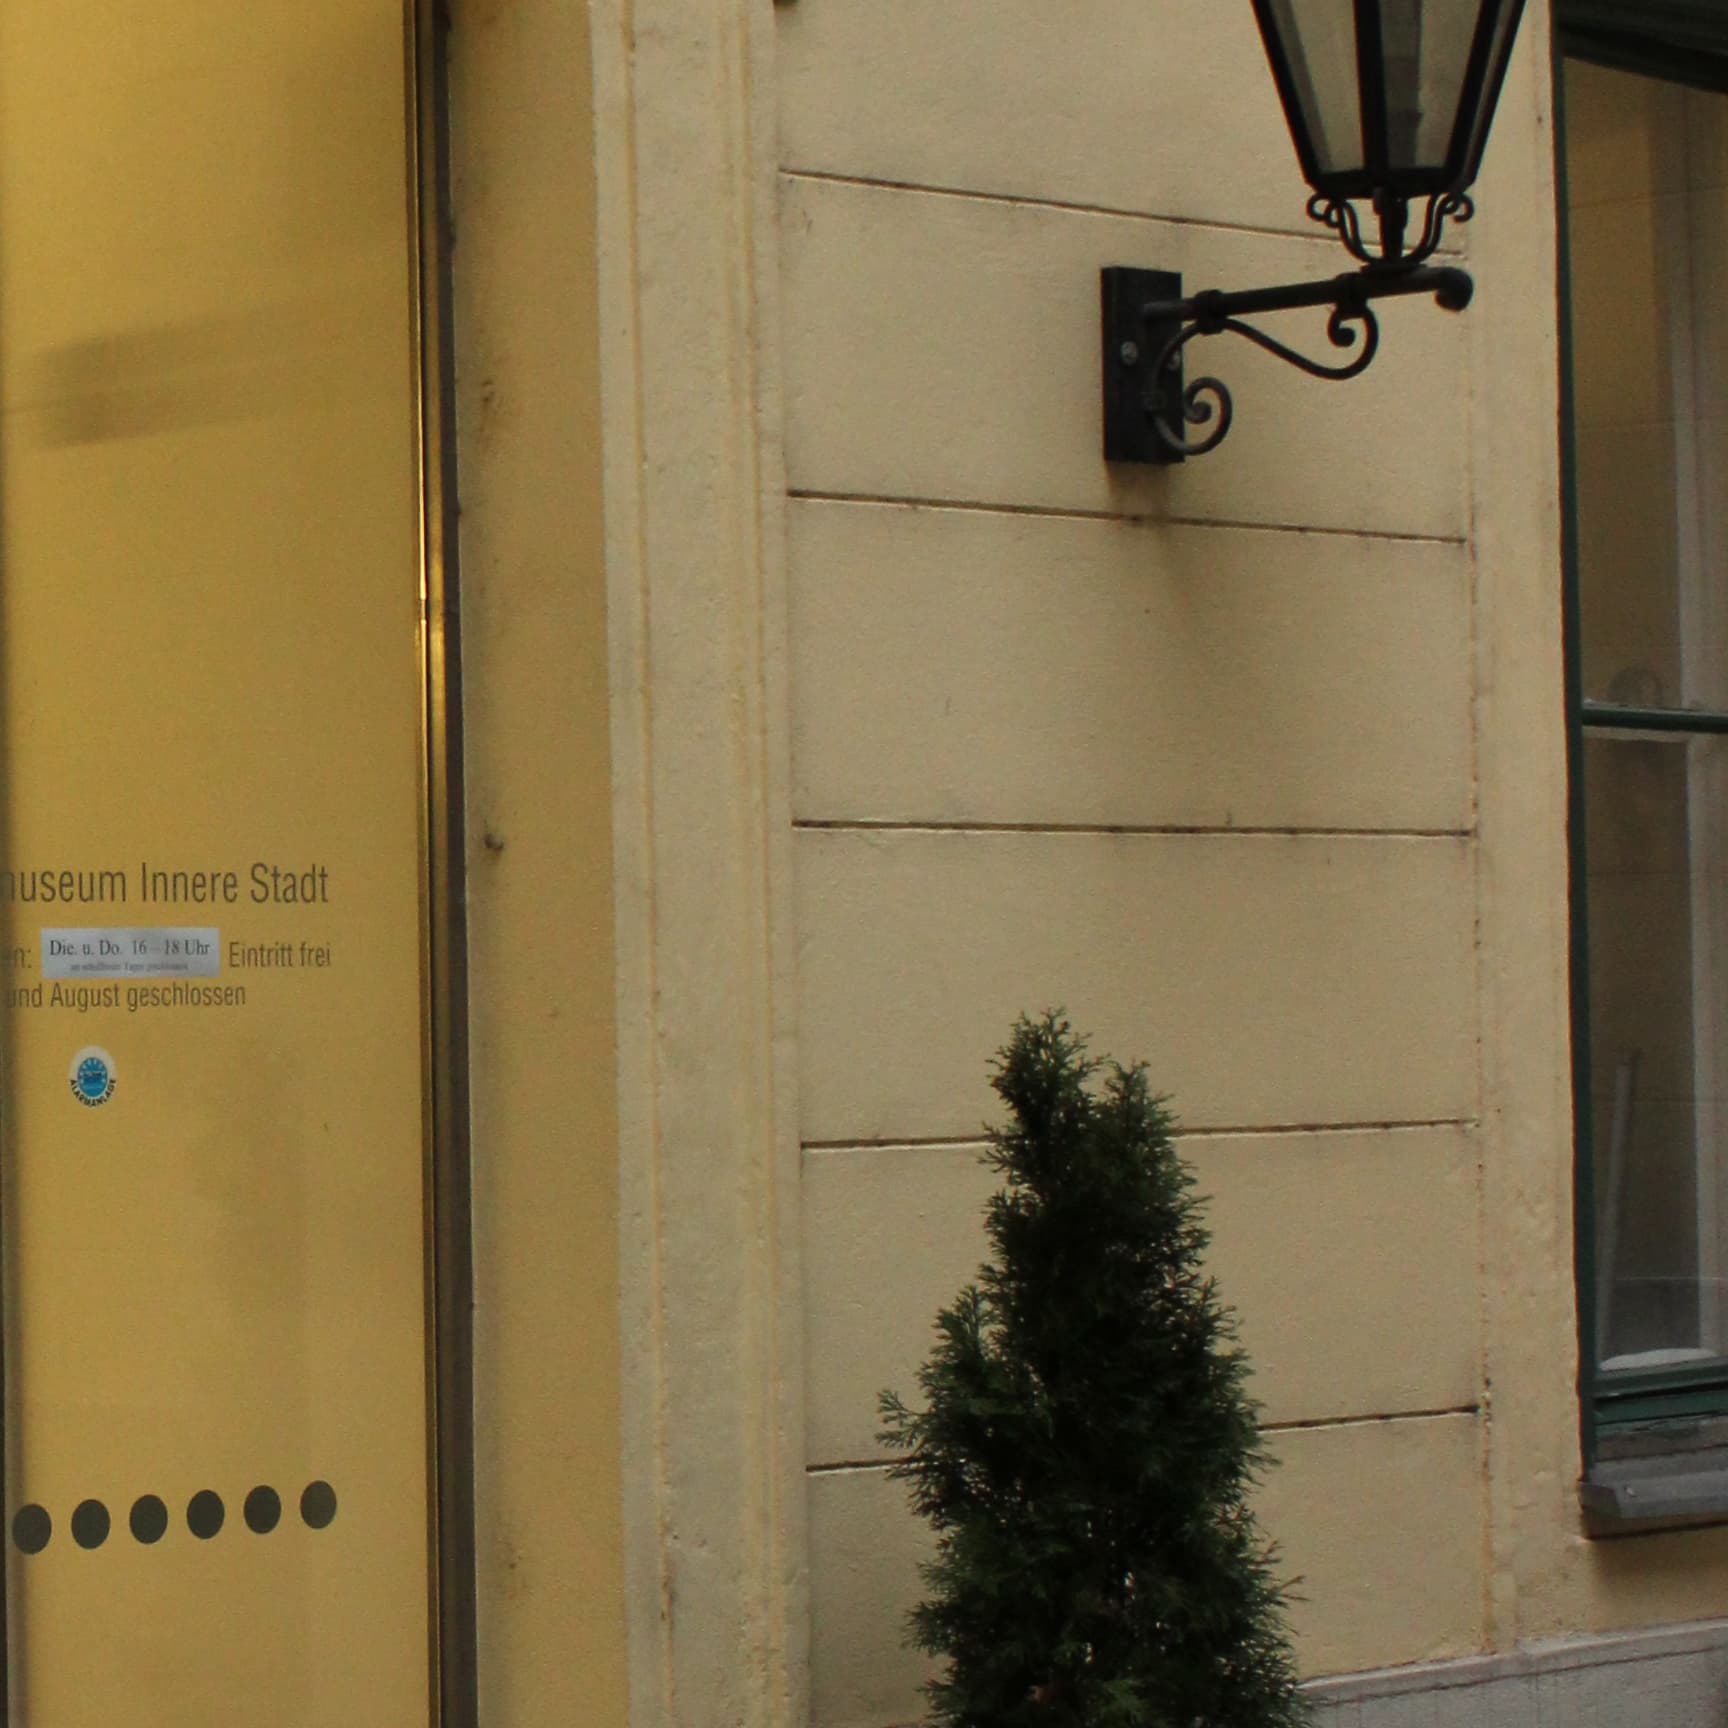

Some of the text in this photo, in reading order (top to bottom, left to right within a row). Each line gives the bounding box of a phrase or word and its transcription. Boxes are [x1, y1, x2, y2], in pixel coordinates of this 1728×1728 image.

[140, 862, 239, 904] Innere
[249, 862, 330, 904] Stadt
[132, 939, 147, 956] 16
[164, 939, 180, 956] 18
[185, 939, 211, 956] Uhr
[228, 941, 294, 969] Eintritt
[299, 941, 332, 969] frei
[8, 981, 42, 1008] und
[50, 982, 120, 1013] August
[127, 981, 247, 1013] geschlossen
